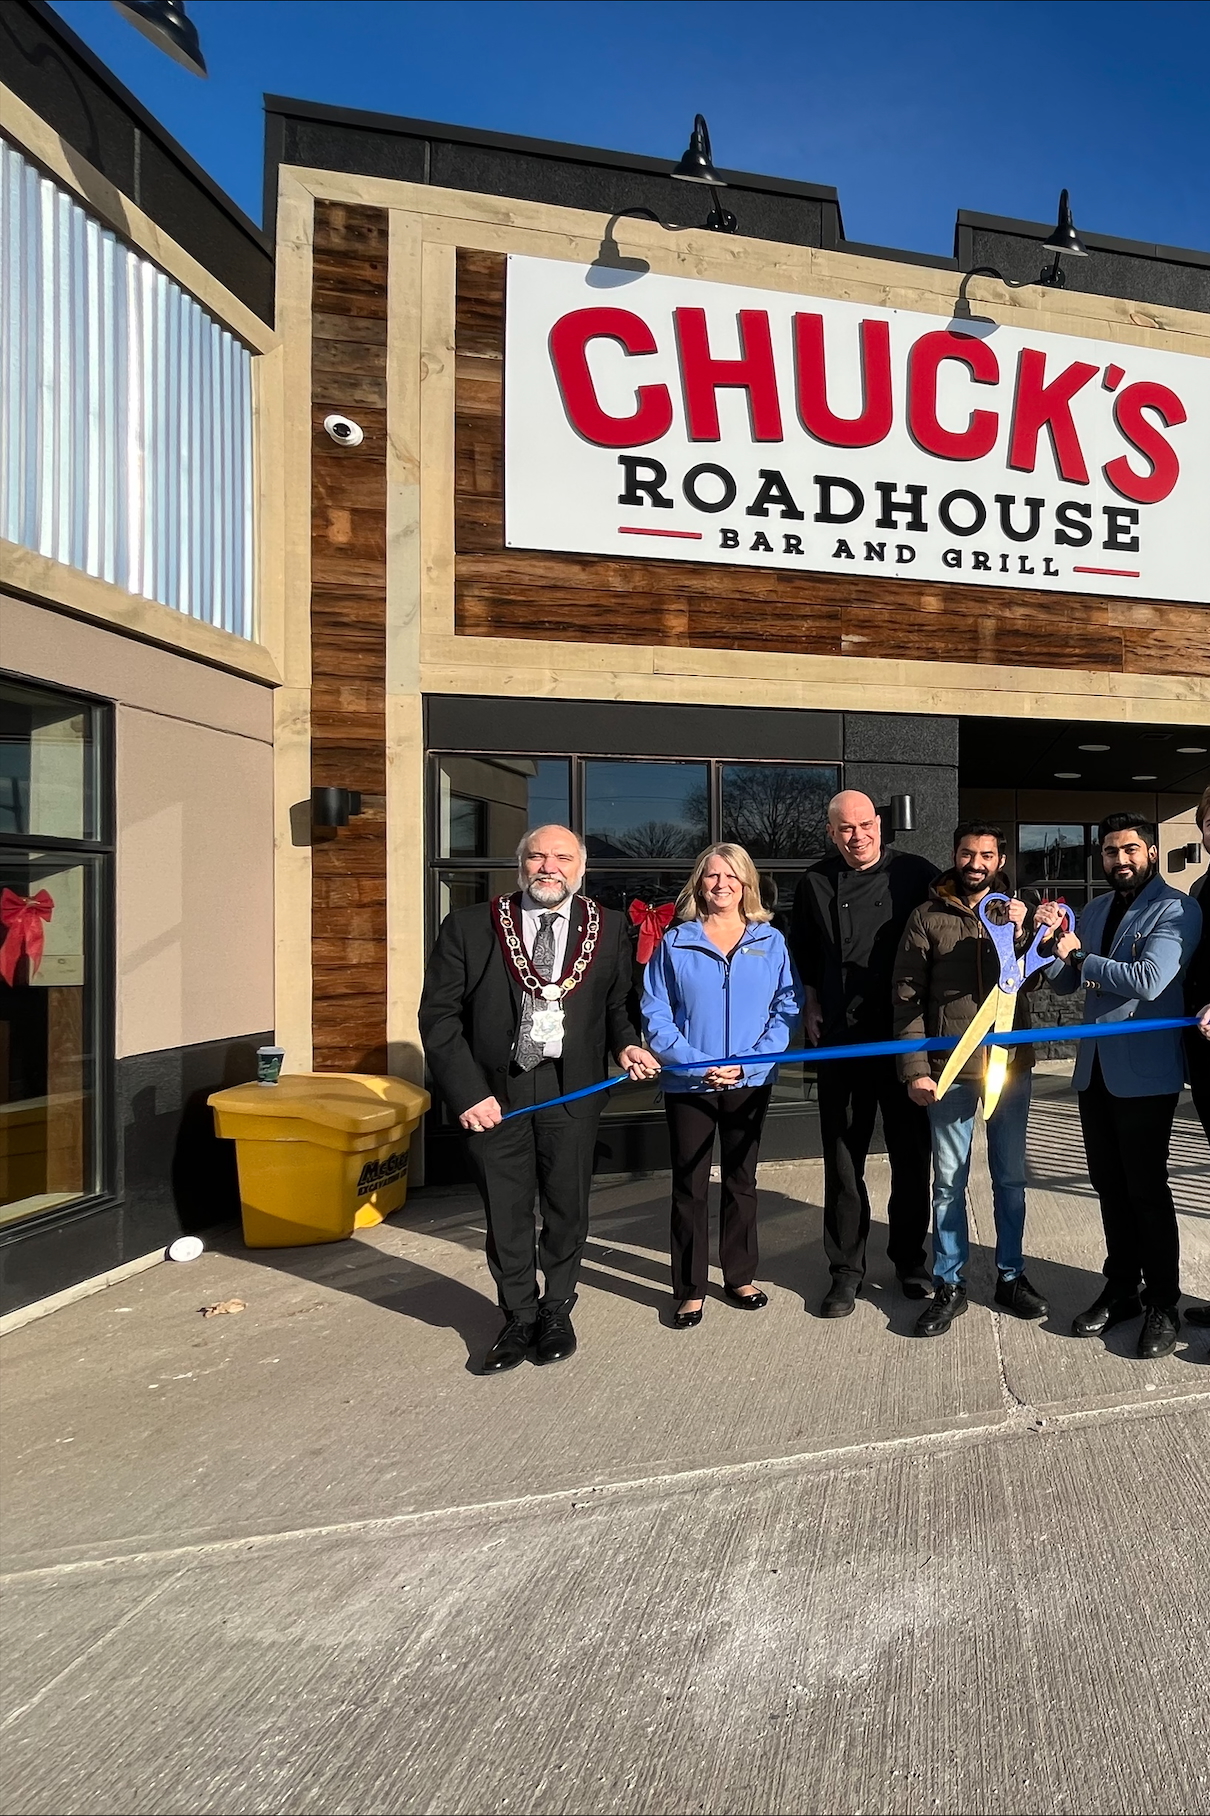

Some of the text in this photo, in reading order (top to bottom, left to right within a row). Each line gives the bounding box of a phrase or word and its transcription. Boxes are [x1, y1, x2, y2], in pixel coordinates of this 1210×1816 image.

[548, 306, 1187, 504] CHUCK'S
[617, 454, 1140, 553] ROADHOUSE
[719, 528, 1059, 577] BAR AND GRILL
